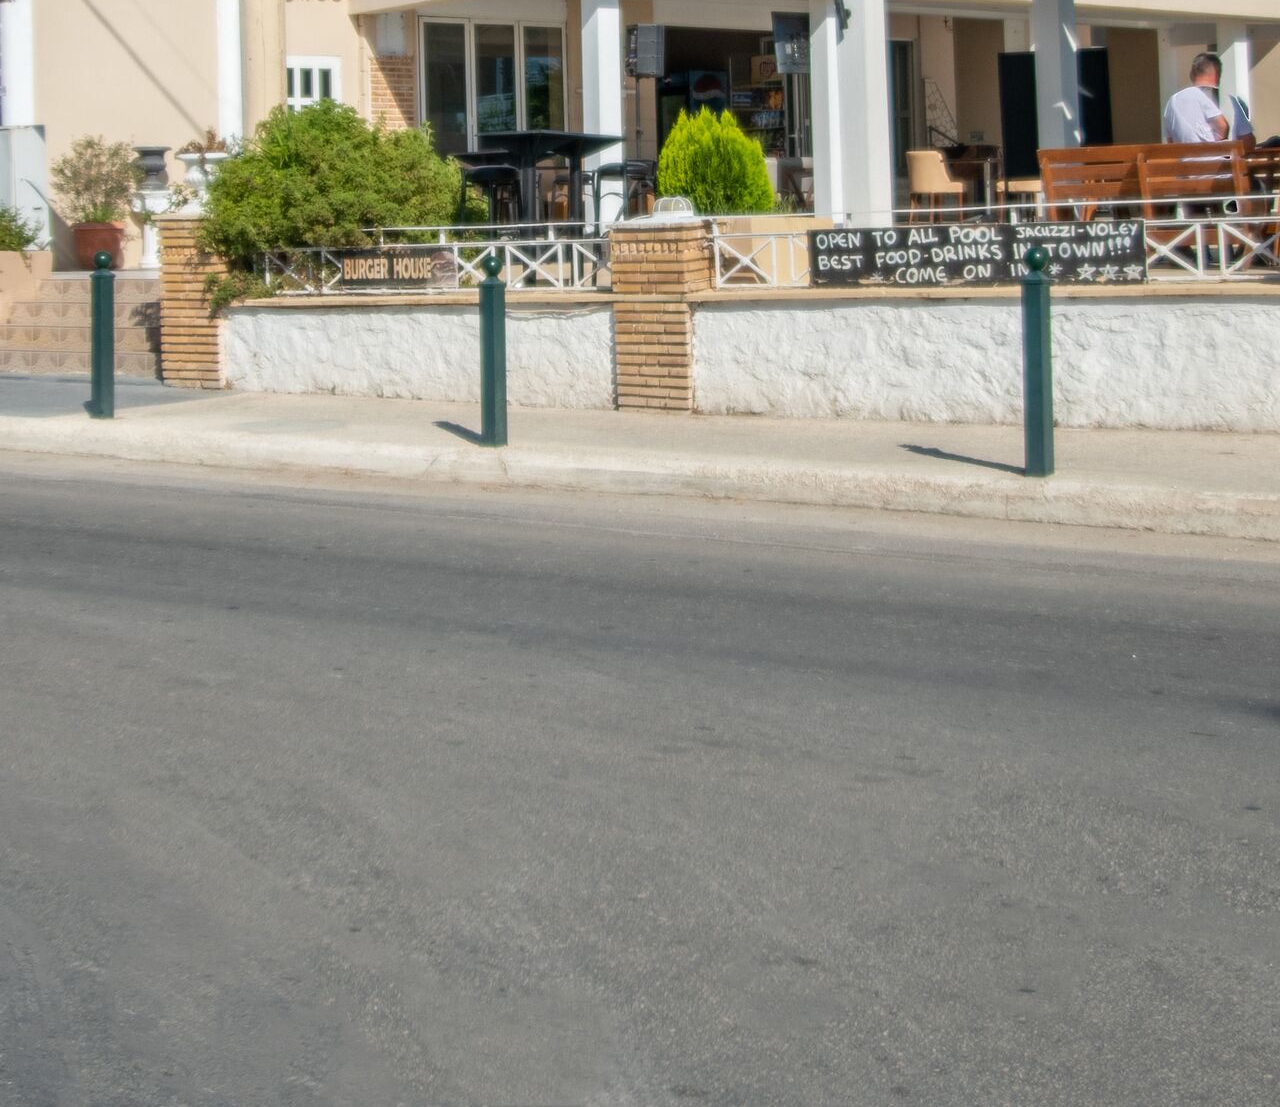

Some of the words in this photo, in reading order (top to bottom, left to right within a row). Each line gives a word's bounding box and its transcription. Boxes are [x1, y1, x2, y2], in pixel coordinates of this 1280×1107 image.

[816, 231, 861, 250] OPEN
[871, 230, 897, 247] TO
[907, 227, 938, 246] ALL
[948, 225, 1003, 244] POOL
[1015, 222, 1138, 239] JACUZZI-VOLEY
[343, 258, 389, 280] BURGER
[393, 257, 432, 280] HOUSE
[818, 255, 863, 271] BEST
[874, 243, 1003, 268] FOOD-DRINKS
[895, 266, 947, 284] COME
[963, 263, 992, 280] ON
